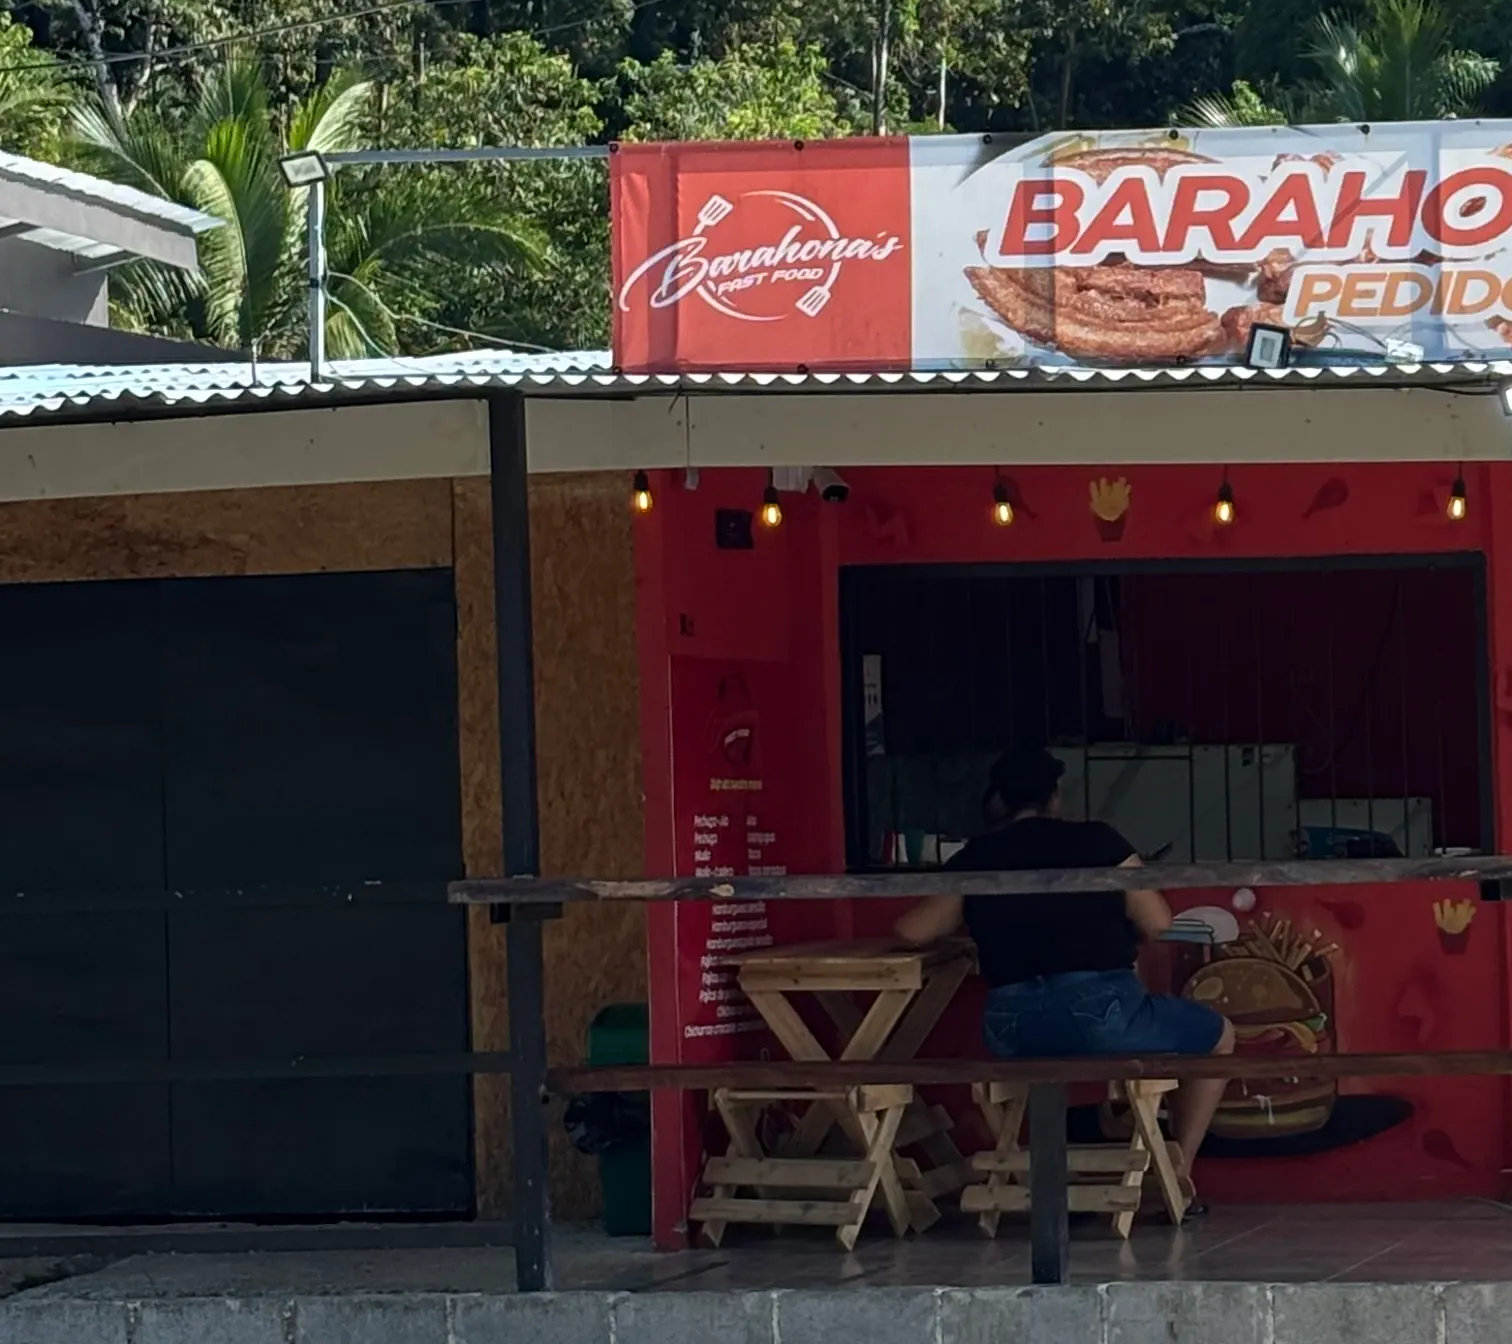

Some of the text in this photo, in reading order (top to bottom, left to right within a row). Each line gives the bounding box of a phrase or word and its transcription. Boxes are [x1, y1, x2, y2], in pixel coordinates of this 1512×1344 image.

[619, 225, 904, 312] Barahona's
[717, 268, 824, 296] FAST FOOD
